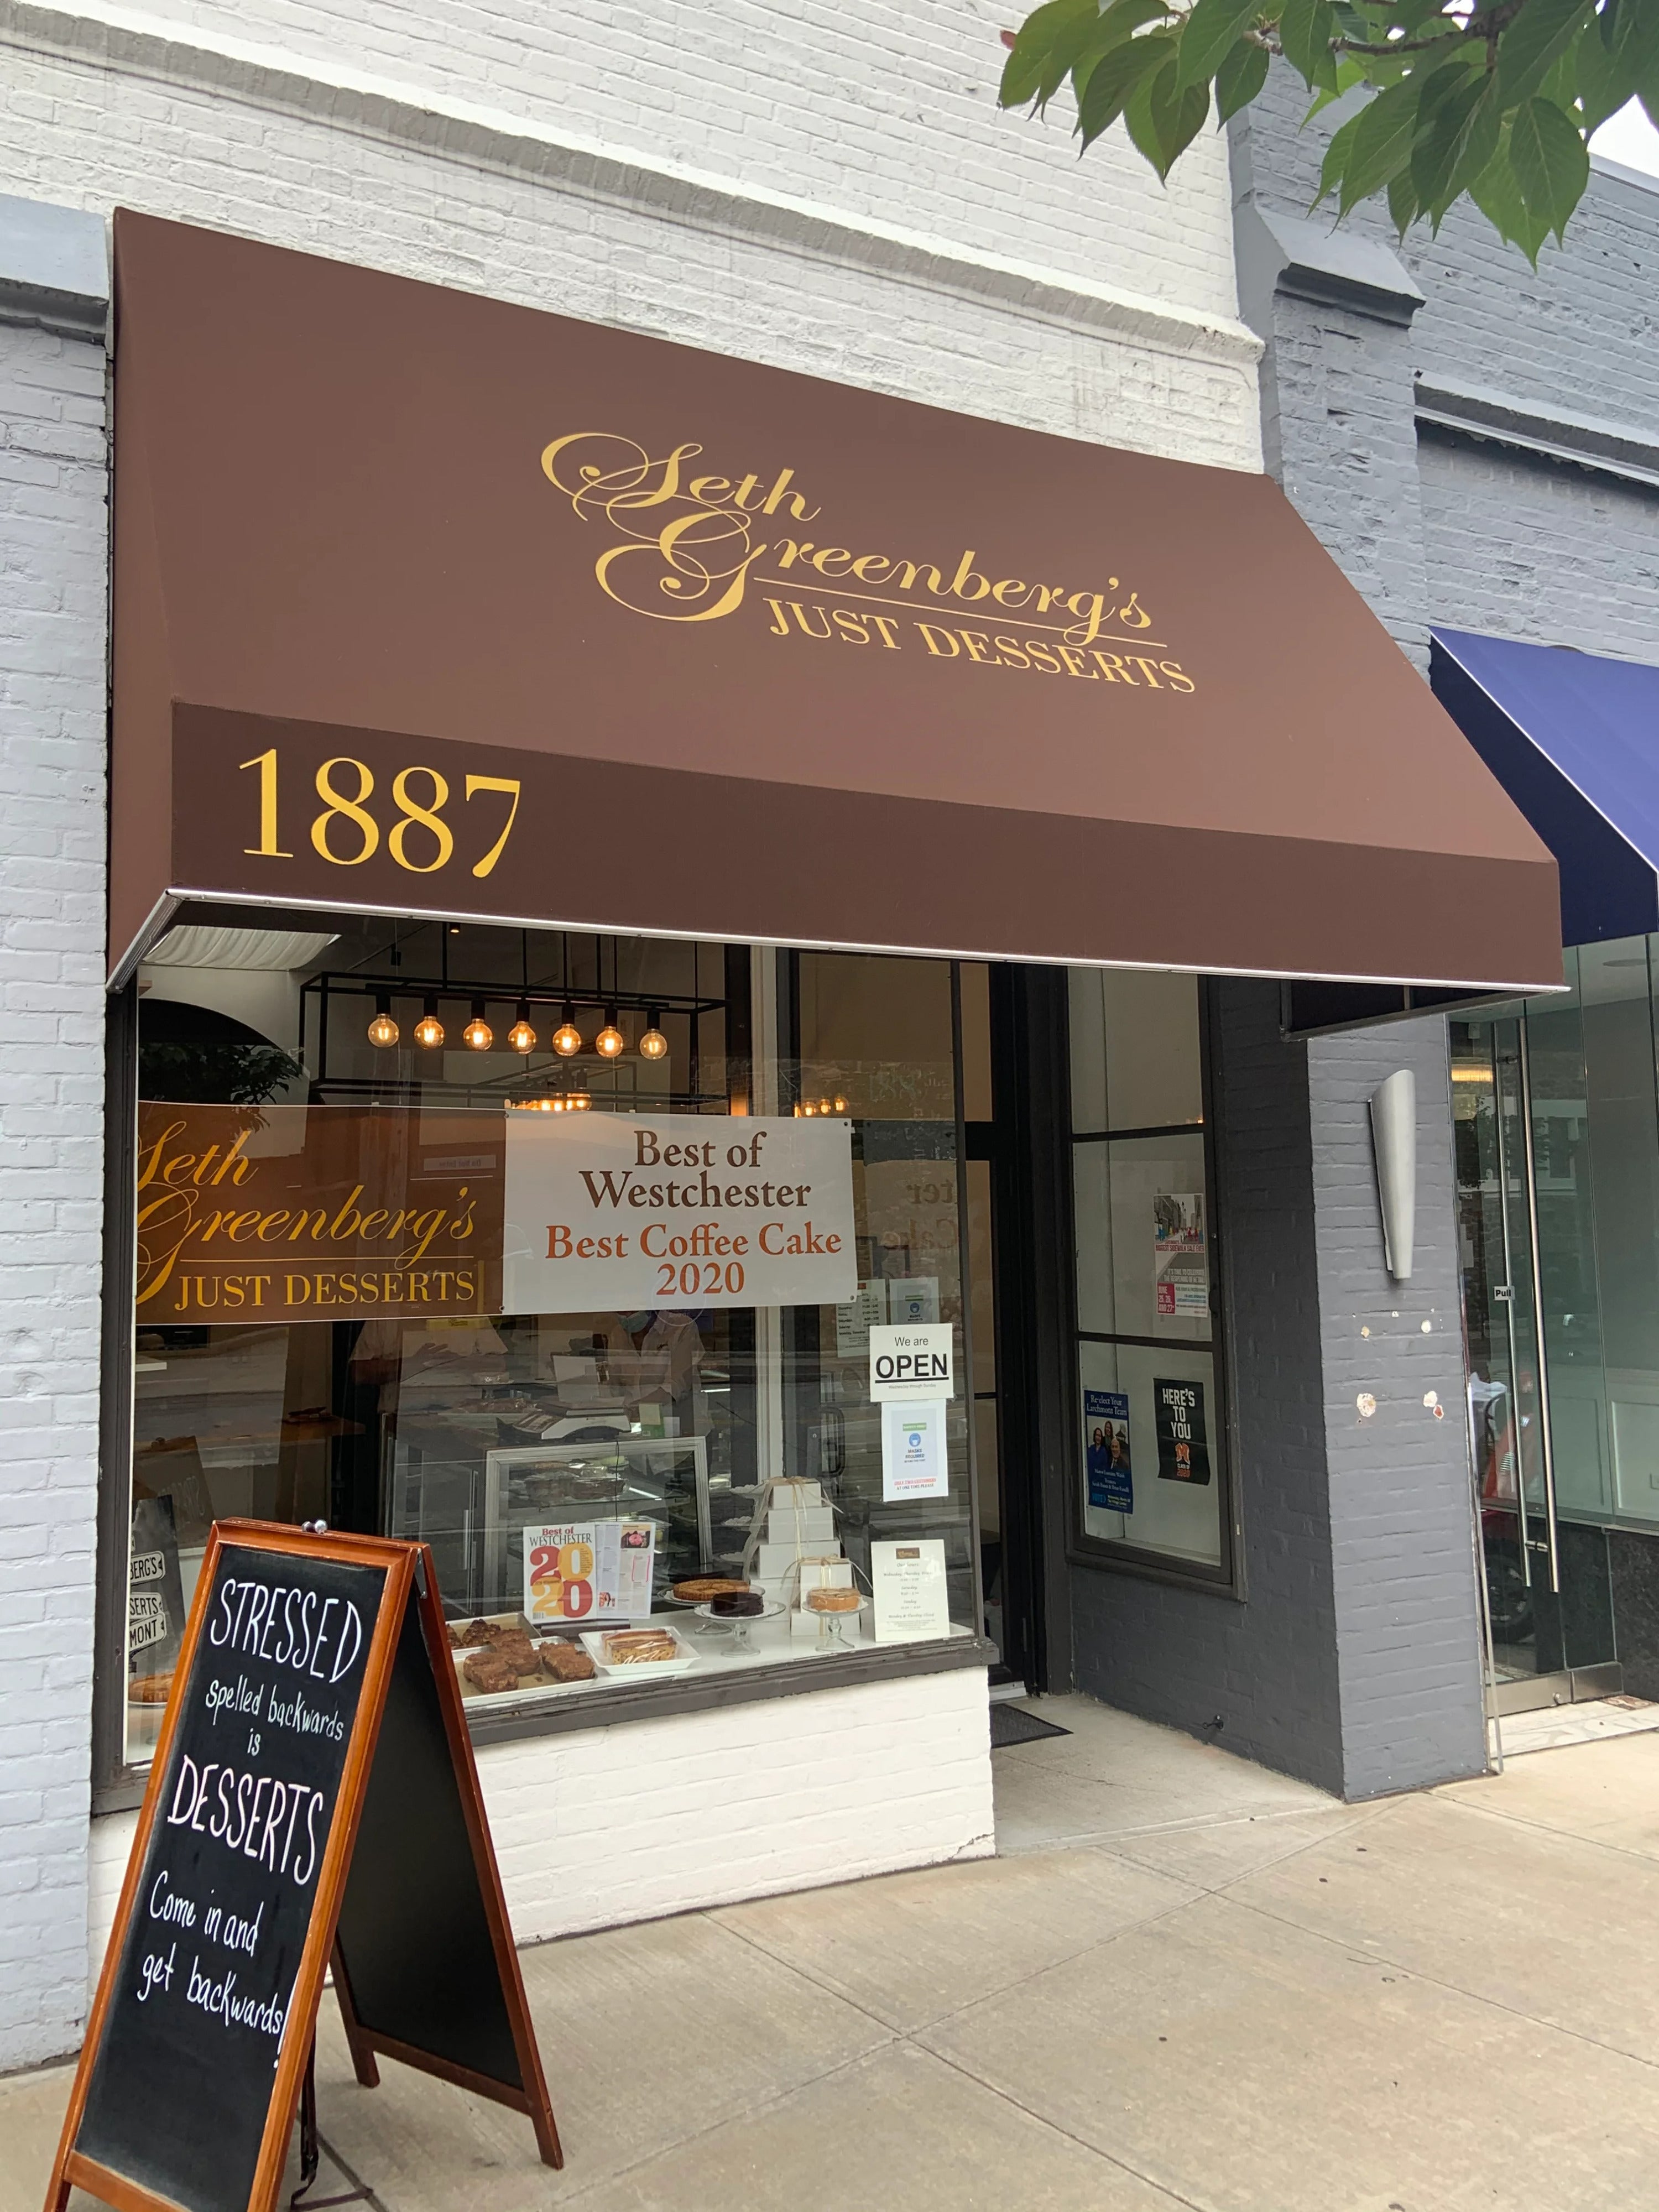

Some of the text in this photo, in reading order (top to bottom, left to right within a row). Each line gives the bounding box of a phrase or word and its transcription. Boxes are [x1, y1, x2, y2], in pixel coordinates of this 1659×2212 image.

[541, 432, 820, 521] Seth
[596, 492, 1151, 645] Greenberg's
[764, 598, 1196, 693] JUST DESSERTS
[239, 749, 520, 878] 1887
[634, 1130, 767, 1167] Best of
[578, 1170, 811, 1208] Westchester
[138, 1182, 477, 1305] Greenberg's
[546, 1221, 842, 1259] Best Coffee Cake
[175, 1272, 474, 1311] JUST DESSERTS
[656, 1261, 744, 1295] 2020
[894, 1337, 929, 1347] We are
[875, 1353, 948, 1379] OPEN
[1091, 1395, 1110, 1405] Re-elect
[1113, 1406, 1127, 1416] Team
[1162, 1388, 1195, 1407] HERE'S
[1172, 1405, 1186, 1422] TO
[1171, 1421, 1191, 1439] YOU
[1175, 1442, 1190, 1465] M
[529, 1533, 592, 1547] WESTCHESTER
[542, 1527, 562, 1536] Best
[129, 1619, 158, 1648] MONT
[210, 1578, 362, 1683] STRESSED
[268, 1685, 344, 1741] backwards
[247, 1728, 261, 1756] is
[168, 1754, 324, 1885] DESSERTS
[150, 1870, 264, 1957] Come in and
[137, 1943, 176, 2001] get
